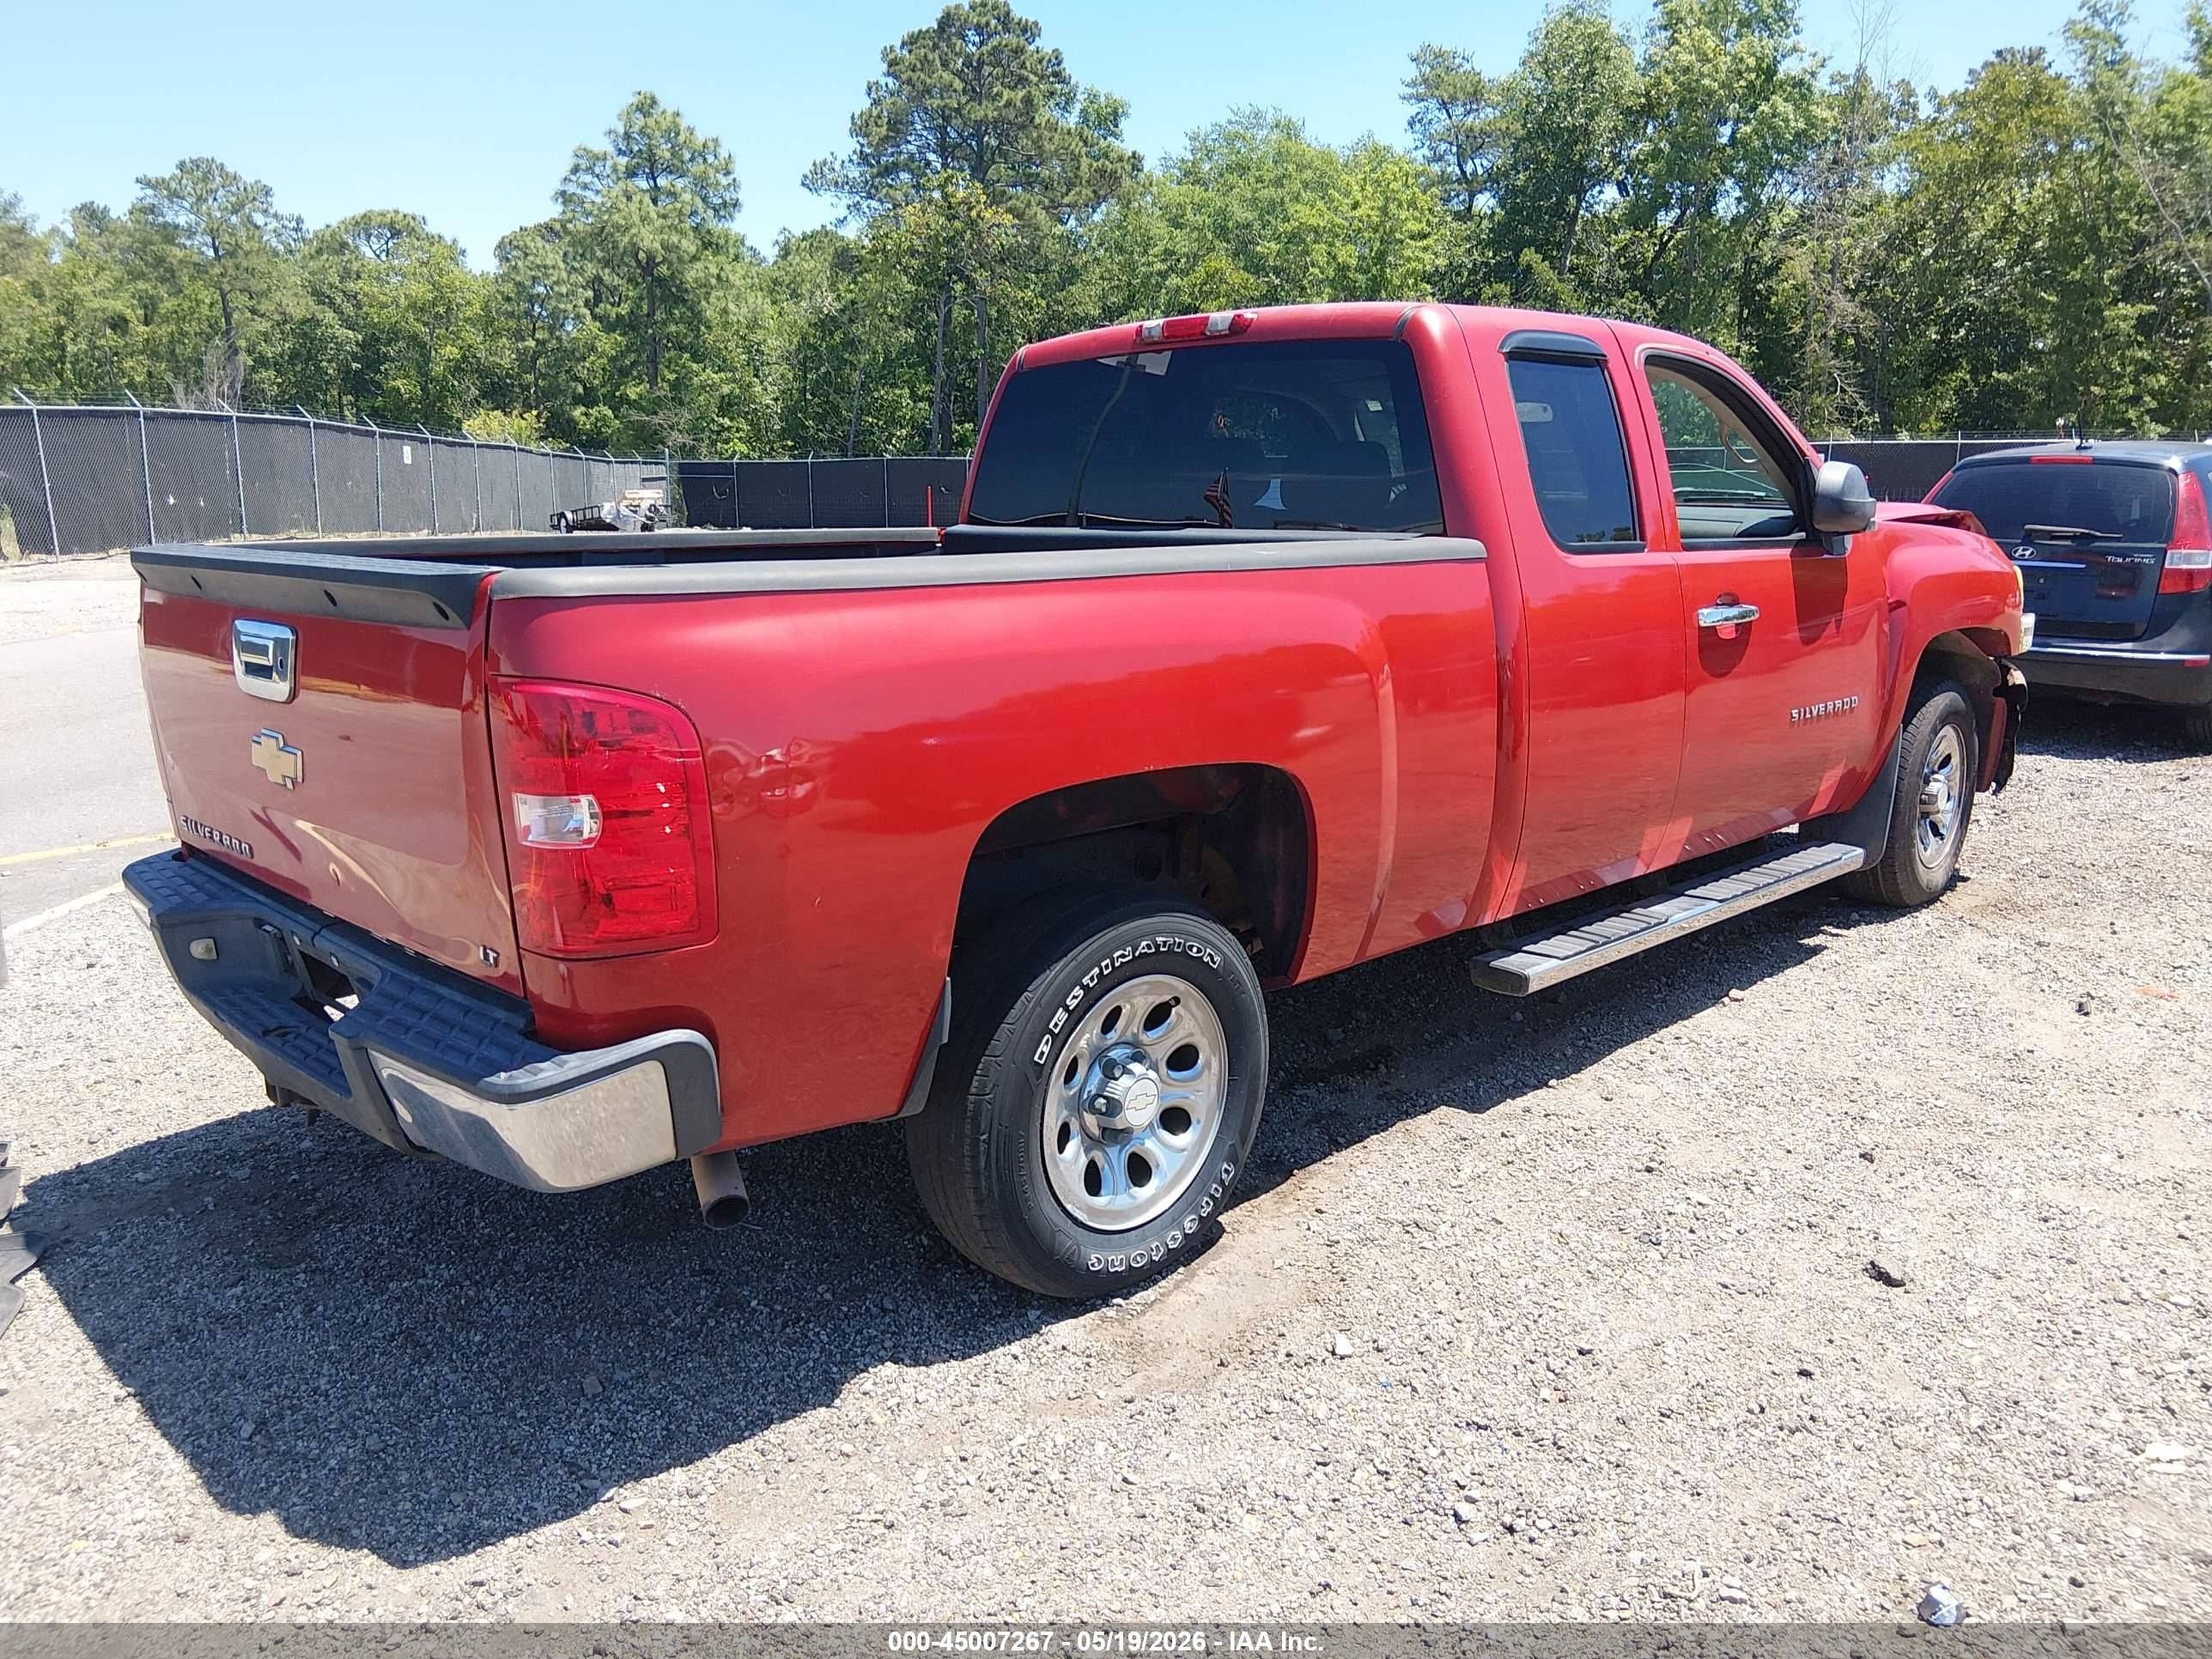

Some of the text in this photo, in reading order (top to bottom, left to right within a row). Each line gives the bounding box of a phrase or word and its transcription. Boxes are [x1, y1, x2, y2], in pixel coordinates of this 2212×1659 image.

[1790, 696, 1859, 722] SILVERADO
[179, 815, 253, 859] SILVERADO
[479, 945, 500, 968] LT
[1034, 937, 1221, 1064] DESTINATION
[1087, 1161, 1235, 1272] Firestone
